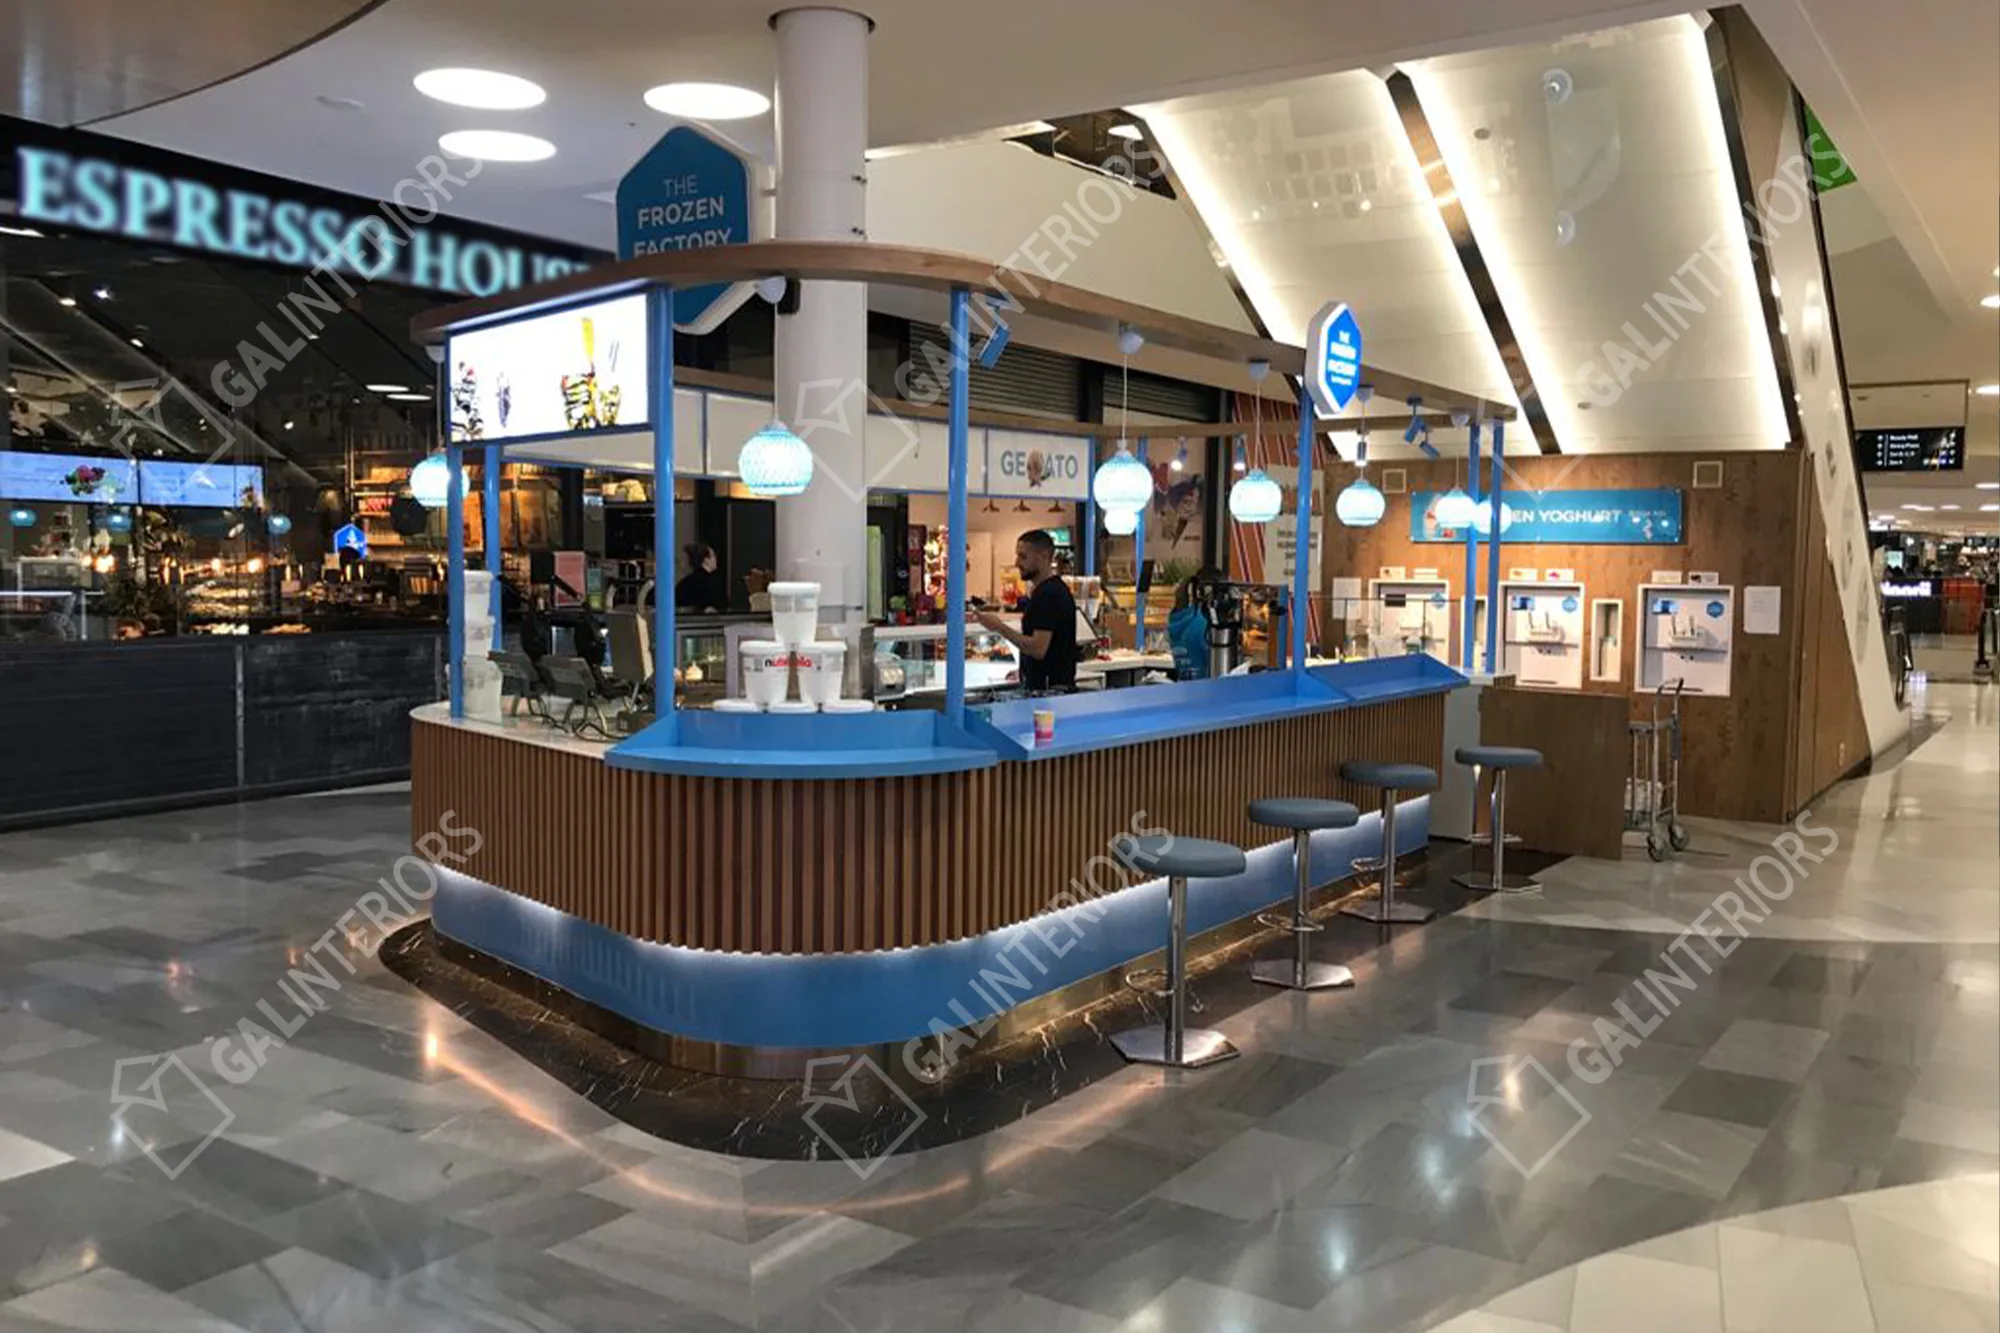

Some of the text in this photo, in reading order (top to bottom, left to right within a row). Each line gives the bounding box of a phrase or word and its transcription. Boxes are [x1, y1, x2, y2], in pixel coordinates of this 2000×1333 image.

[662, 174, 698, 197] THE
[16, 146, 399, 280] ESPRESSO
[637, 196, 725, 230] FROZEN
[633, 228, 733, 259] FACTORY
[1538, 509, 1622, 523] YOGHURT
